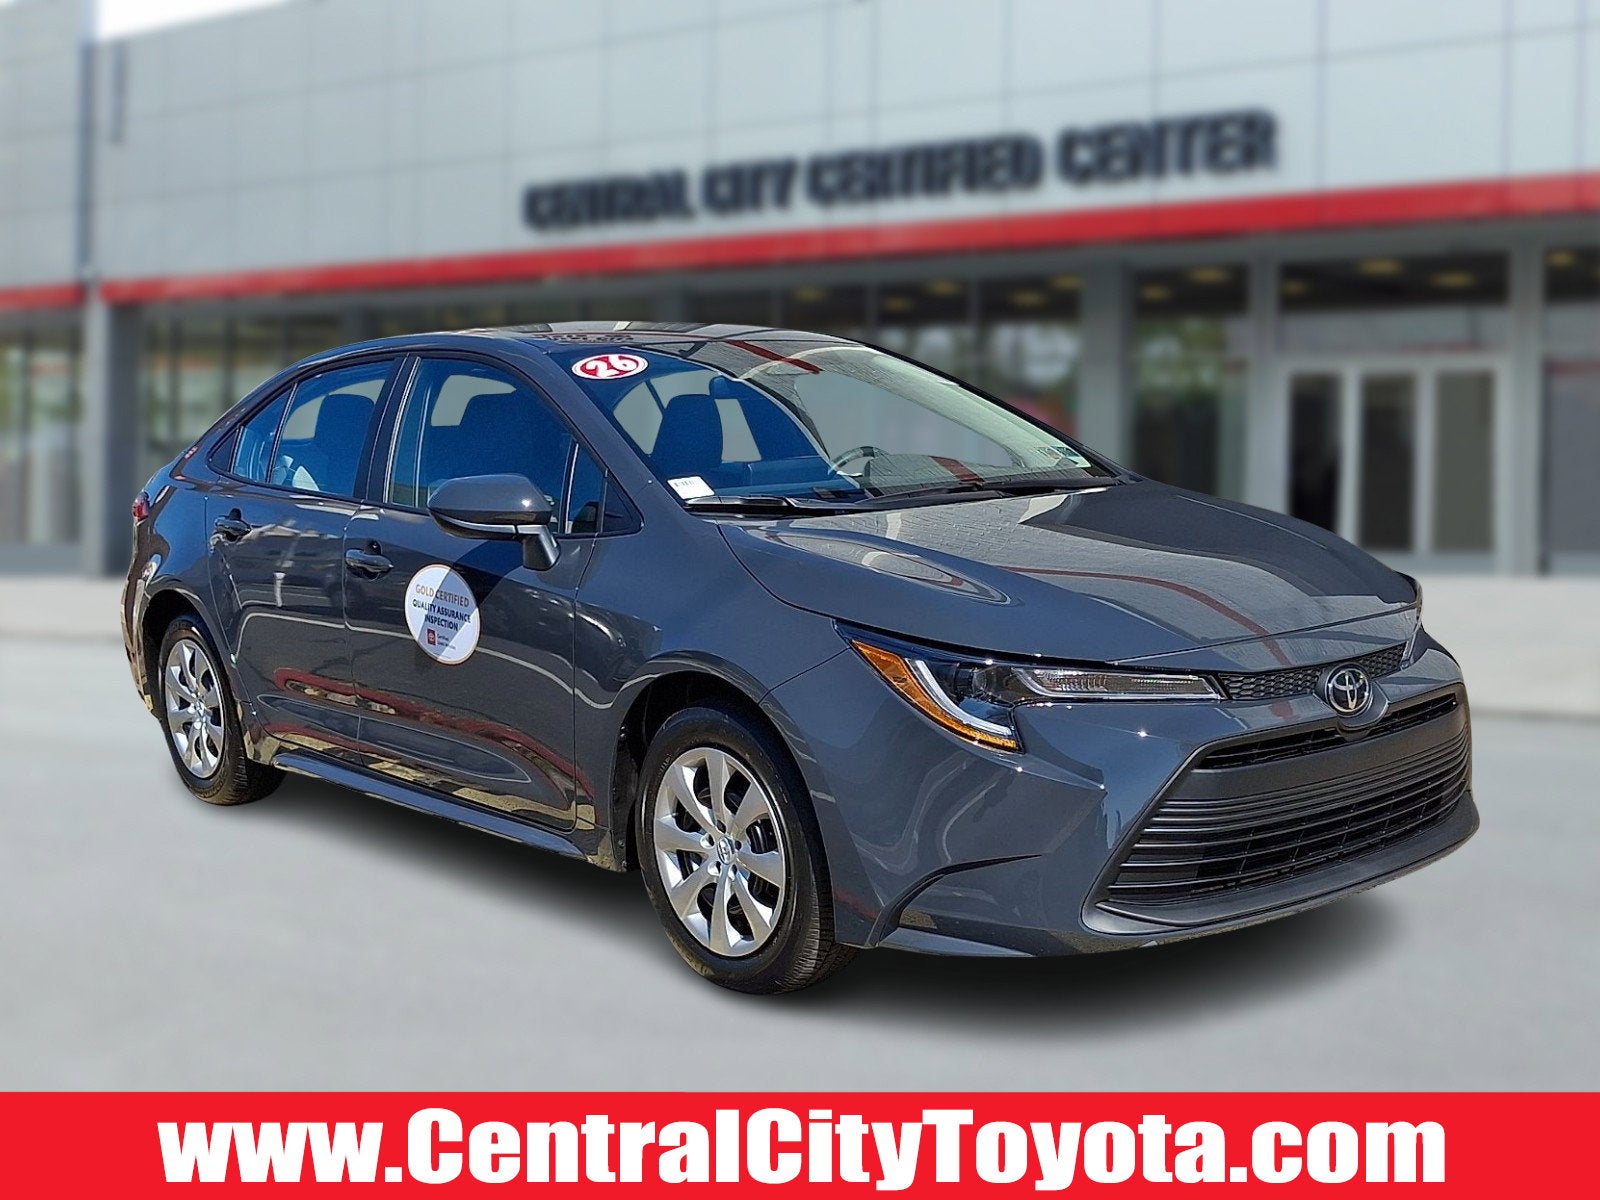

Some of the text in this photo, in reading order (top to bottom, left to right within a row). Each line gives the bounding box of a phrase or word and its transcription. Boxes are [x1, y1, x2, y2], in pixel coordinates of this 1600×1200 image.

[701, 157, 800, 216] CITY
[805, 134, 1044, 207] CERTIFIED
[1056, 109, 1277, 187] CENTER
[584, 355, 639, 378] 26
[415, 584, 470, 608] GOLD CERTIFIED
[412, 598, 471, 623] QUALITY ASSURANCE
[424, 614, 459, 632] INSPECTION
